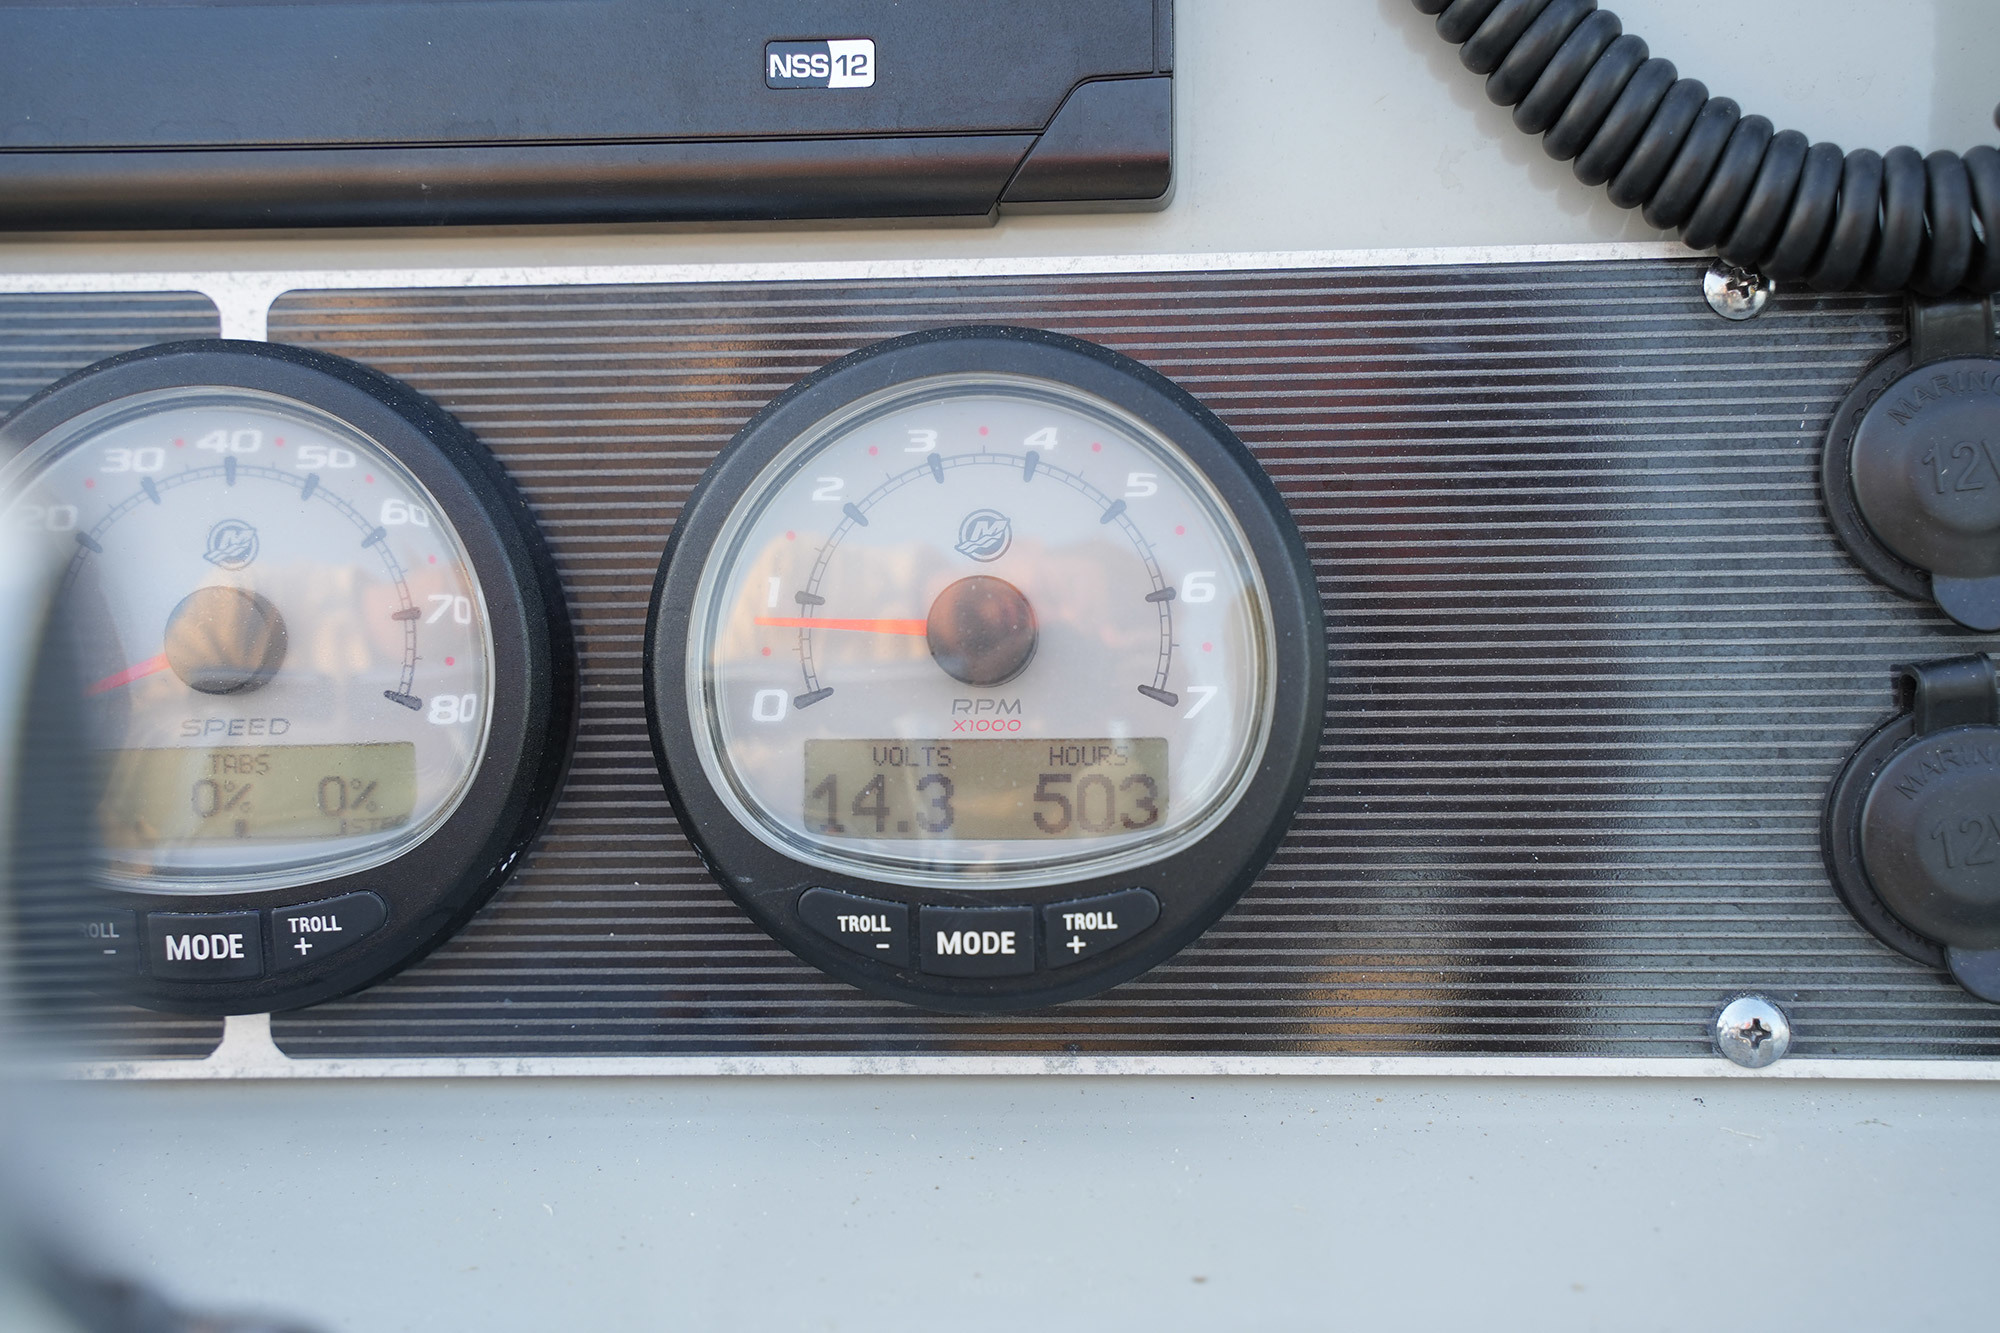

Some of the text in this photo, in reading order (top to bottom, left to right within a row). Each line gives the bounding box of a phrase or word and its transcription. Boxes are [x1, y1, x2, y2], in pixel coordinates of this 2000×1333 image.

[196, 429, 263, 453] 40
[904, 429, 938, 452] 3
[1024, 427, 1058, 450] 4
[101, 447, 166, 473] 30
[296, 446, 357, 470] 50
[812, 477, 845, 500] 2
[1125, 472, 1158, 497] 5
[16, 503, 79, 532] 20
[380, 498, 430, 528] 60
[766, 577, 781, 608] 1
[1181, 571, 1216, 602] 6
[425, 594, 472, 625] 70
[426, 693, 477, 725] 80
[751, 689, 788, 721] 0
[951, 698, 1022, 715] RPM
[1183, 687, 1218, 719] 7
[180, 717, 291, 738] SPEED
[951, 719, 1022, 733] X1000
[208, 753, 271, 776] TABS
[872, 746, 952, 766] VOLTS
[1049, 746, 1129, 766] HOURS
[191, 779, 252, 818] 0%
[318, 775, 378, 816] 0%
[811, 773, 954, 832] 14.3
[1033, 773, 1159, 834] 503
[288, 915, 343, 933] TROLL
[837, 915, 892, 932] TROLL
[1062, 911, 1119, 931] TROLL
[165, 933, 245, 961] MODE
[936, 931, 1016, 955] MODE
